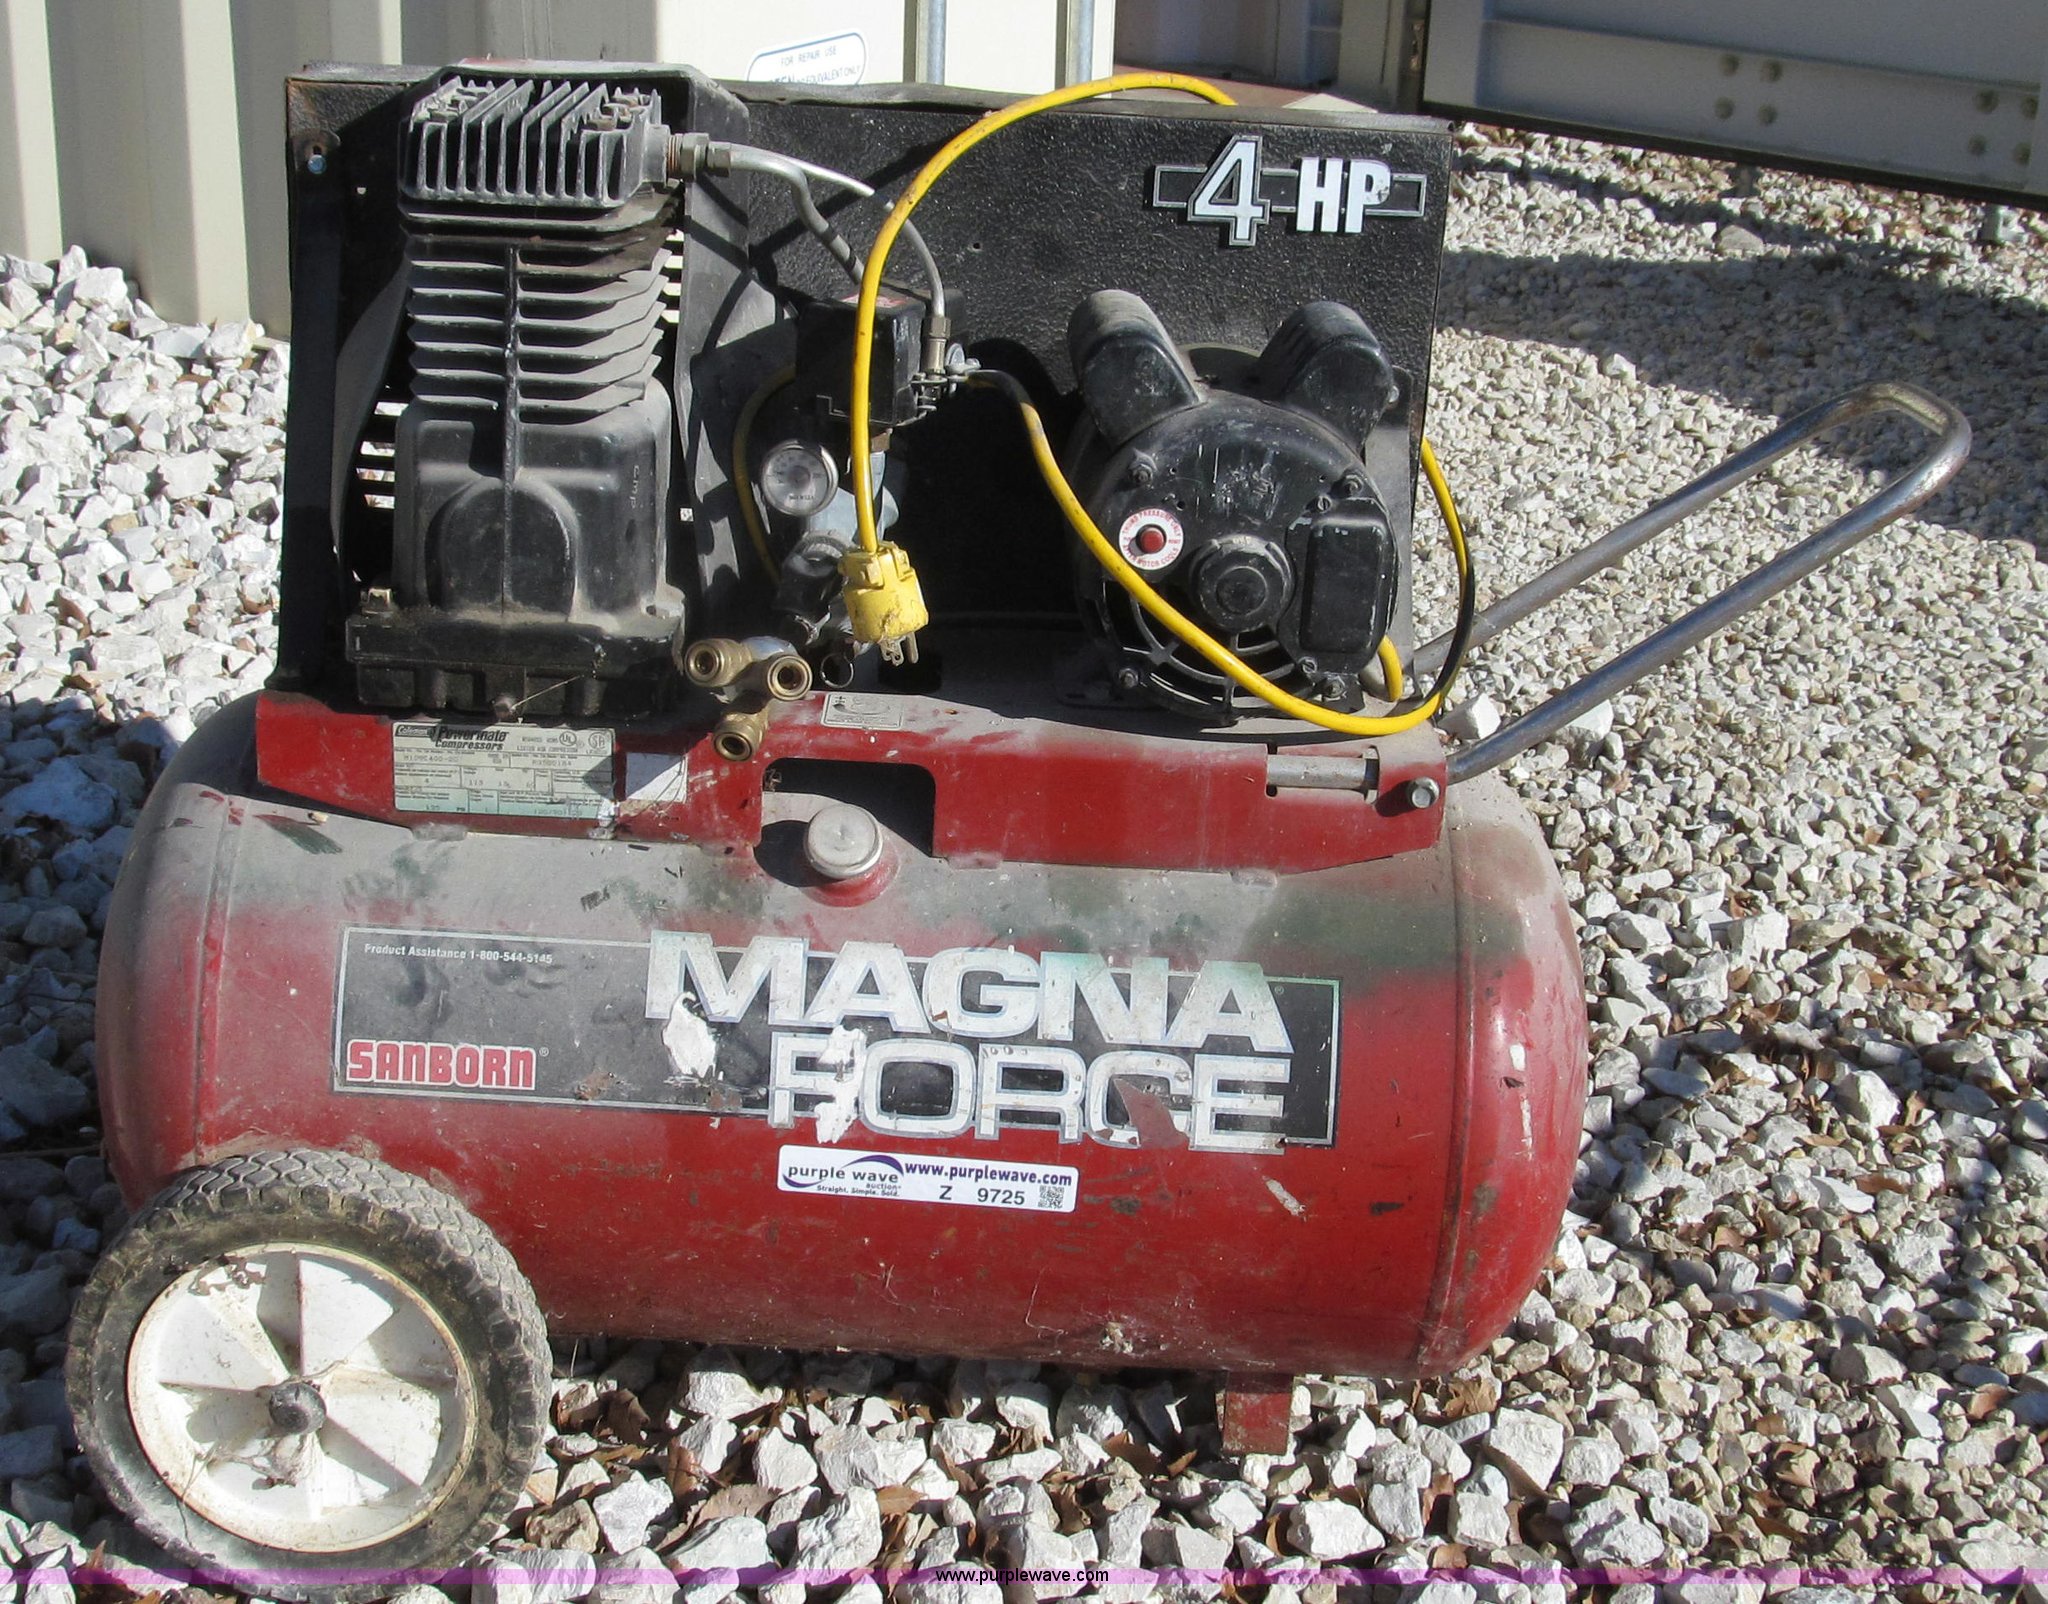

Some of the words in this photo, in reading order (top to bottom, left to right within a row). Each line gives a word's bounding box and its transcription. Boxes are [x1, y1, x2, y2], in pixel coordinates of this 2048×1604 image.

[781, 56, 794, 66] FOR
[798, 49, 820, 62] REPAIR
[825, 45, 837, 57] USE
[1187, 135, 1270, 246] 4
[1296, 156, 1391, 233] HP
[439, 726, 510, 742] Powermate
[435, 740, 504, 751] Compressors
[364, 943, 405, 956] Product
[408, 945, 467, 960] Assistance
[469, 950, 553, 964] 1-800-544-5145
[645, 930, 1296, 1054] MAGNA
[347, 1039, 537, 1090] SANBORN
[768, 1031, 1292, 1155] FORCE
[788, 1166, 846, 1180] purple
[852, 1170, 899, 1183] wave
[904, 1161, 1072, 1187] www.purplewave.com
[939, 1185, 952, 1201] Z
[977, 1187, 1026, 1206] 9725
